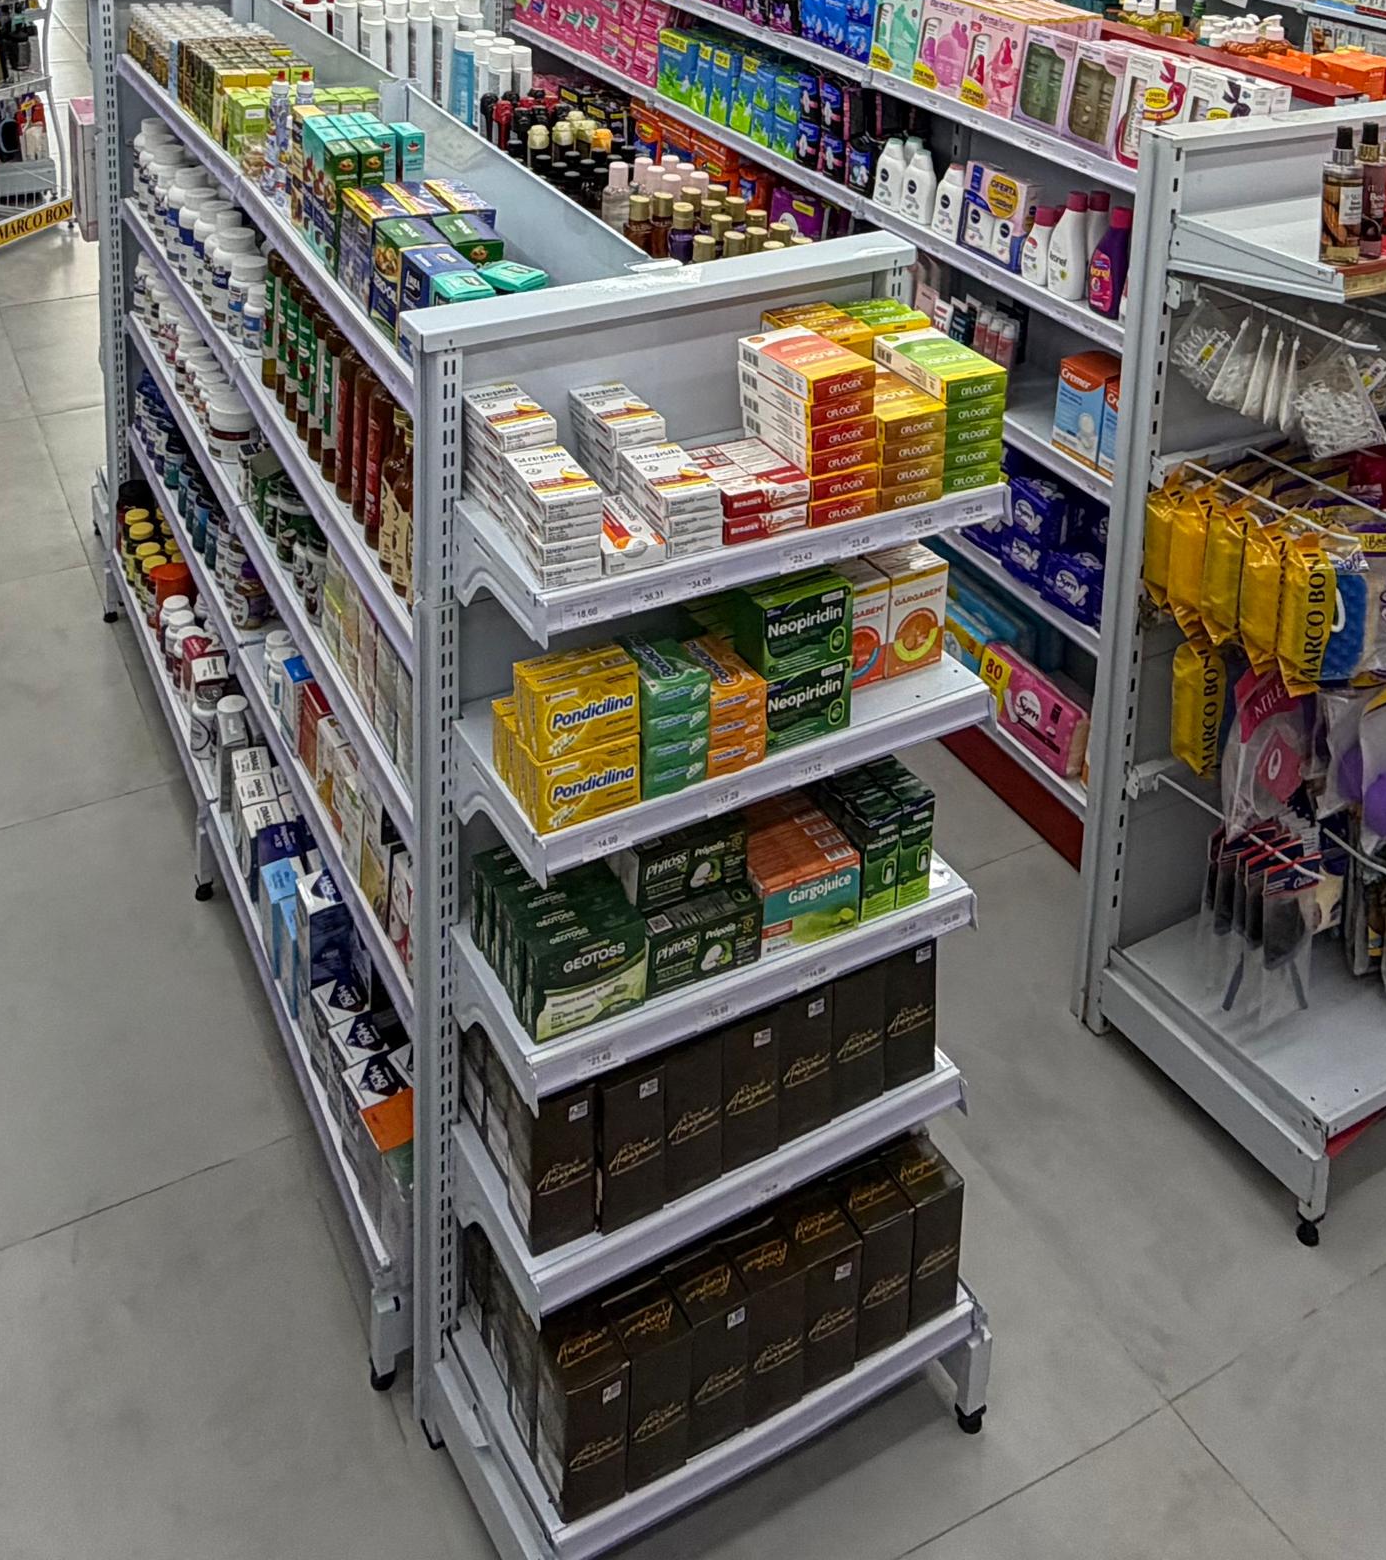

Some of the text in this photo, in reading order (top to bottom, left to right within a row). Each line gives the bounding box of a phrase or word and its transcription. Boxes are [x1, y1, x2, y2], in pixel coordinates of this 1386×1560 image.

[45, 202, 73, 224] BONI
[1061, 368, 1093, 391] Cremer
[468, 386, 518, 399] Strepsils
[578, 386, 626, 398] Strepsils
[513, 451, 567, 464] Strepsils
[631, 447, 681, 461] Strepsils
[547, 502, 575, 511] Strepsils
[670, 497, 696, 507] Strepsils
[547, 524, 574, 534] Strepsils
[545, 546, 573, 556] Strepsils
[545, 567, 572, 578] Strepsils
[894, 586, 944, 607] GARGABEM
[853, 604, 886, 619] GABEM
[1299, 551, 1327, 683] MARCO BONI
[767, 606, 843, 639] Neopiridin
[986, 659, 1004, 680] 80
[767, 681, 842, 714] Neopiridin
[552, 695, 634, 729] Pondicilina
[1201, 698, 1219, 773] MARCO
[553, 766, 635, 801] Pondicilina
[694, 840, 726, 858] Própolis
[788, 873, 852, 904] Gargojuice
[549, 928, 589, 945] GEOTOSS
[705, 922, 736, 940] Própolis
[563, 942, 626, 974] GEOTOSS
